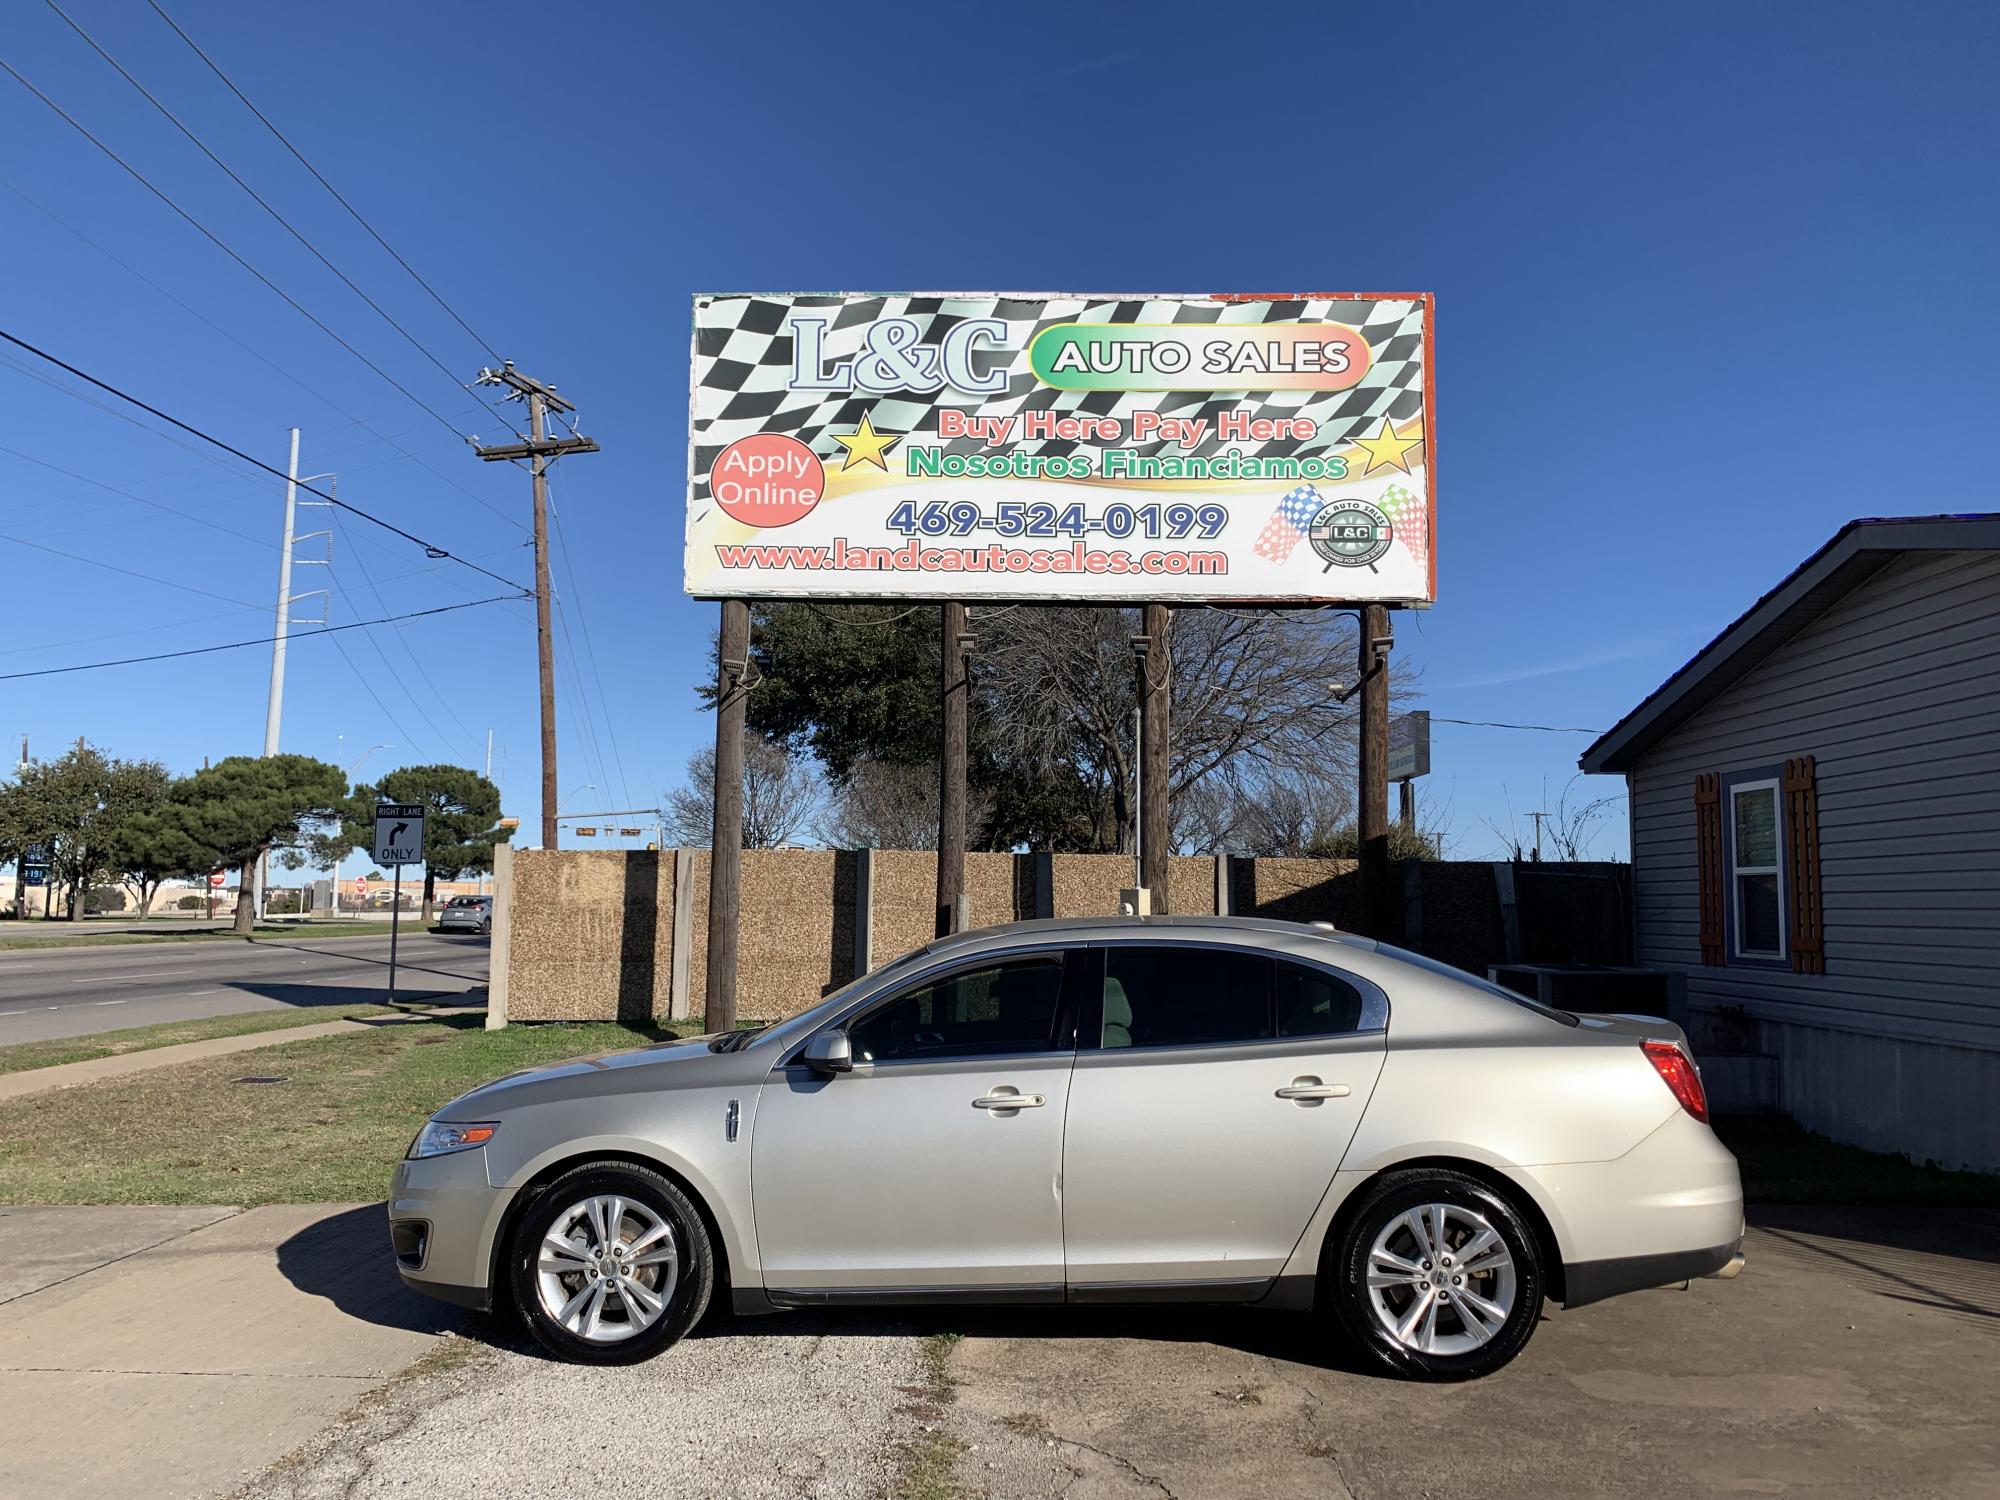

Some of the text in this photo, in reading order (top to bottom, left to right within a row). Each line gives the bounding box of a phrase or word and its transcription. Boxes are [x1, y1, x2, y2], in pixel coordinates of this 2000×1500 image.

[788, 317, 1009, 393] L&C
[1051, 341, 1350, 374] AUTO SALES
[937, 410, 1316, 448] Buy Here Pay Here
[717, 449, 817, 506] Apply Online
[907, 446, 1349, 479] Nosotros Financiamos
[886, 501, 1229, 539] 469-524-0199
[1315, 502, 1385, 525] L&C AUTO SALES
[1334, 527, 1368, 539] L&C
[715, 538, 1228, 575] www.landcautosales.com
[378, 807, 423, 816] RIGHT LANE
[382, 848, 414, 860] ONLY
